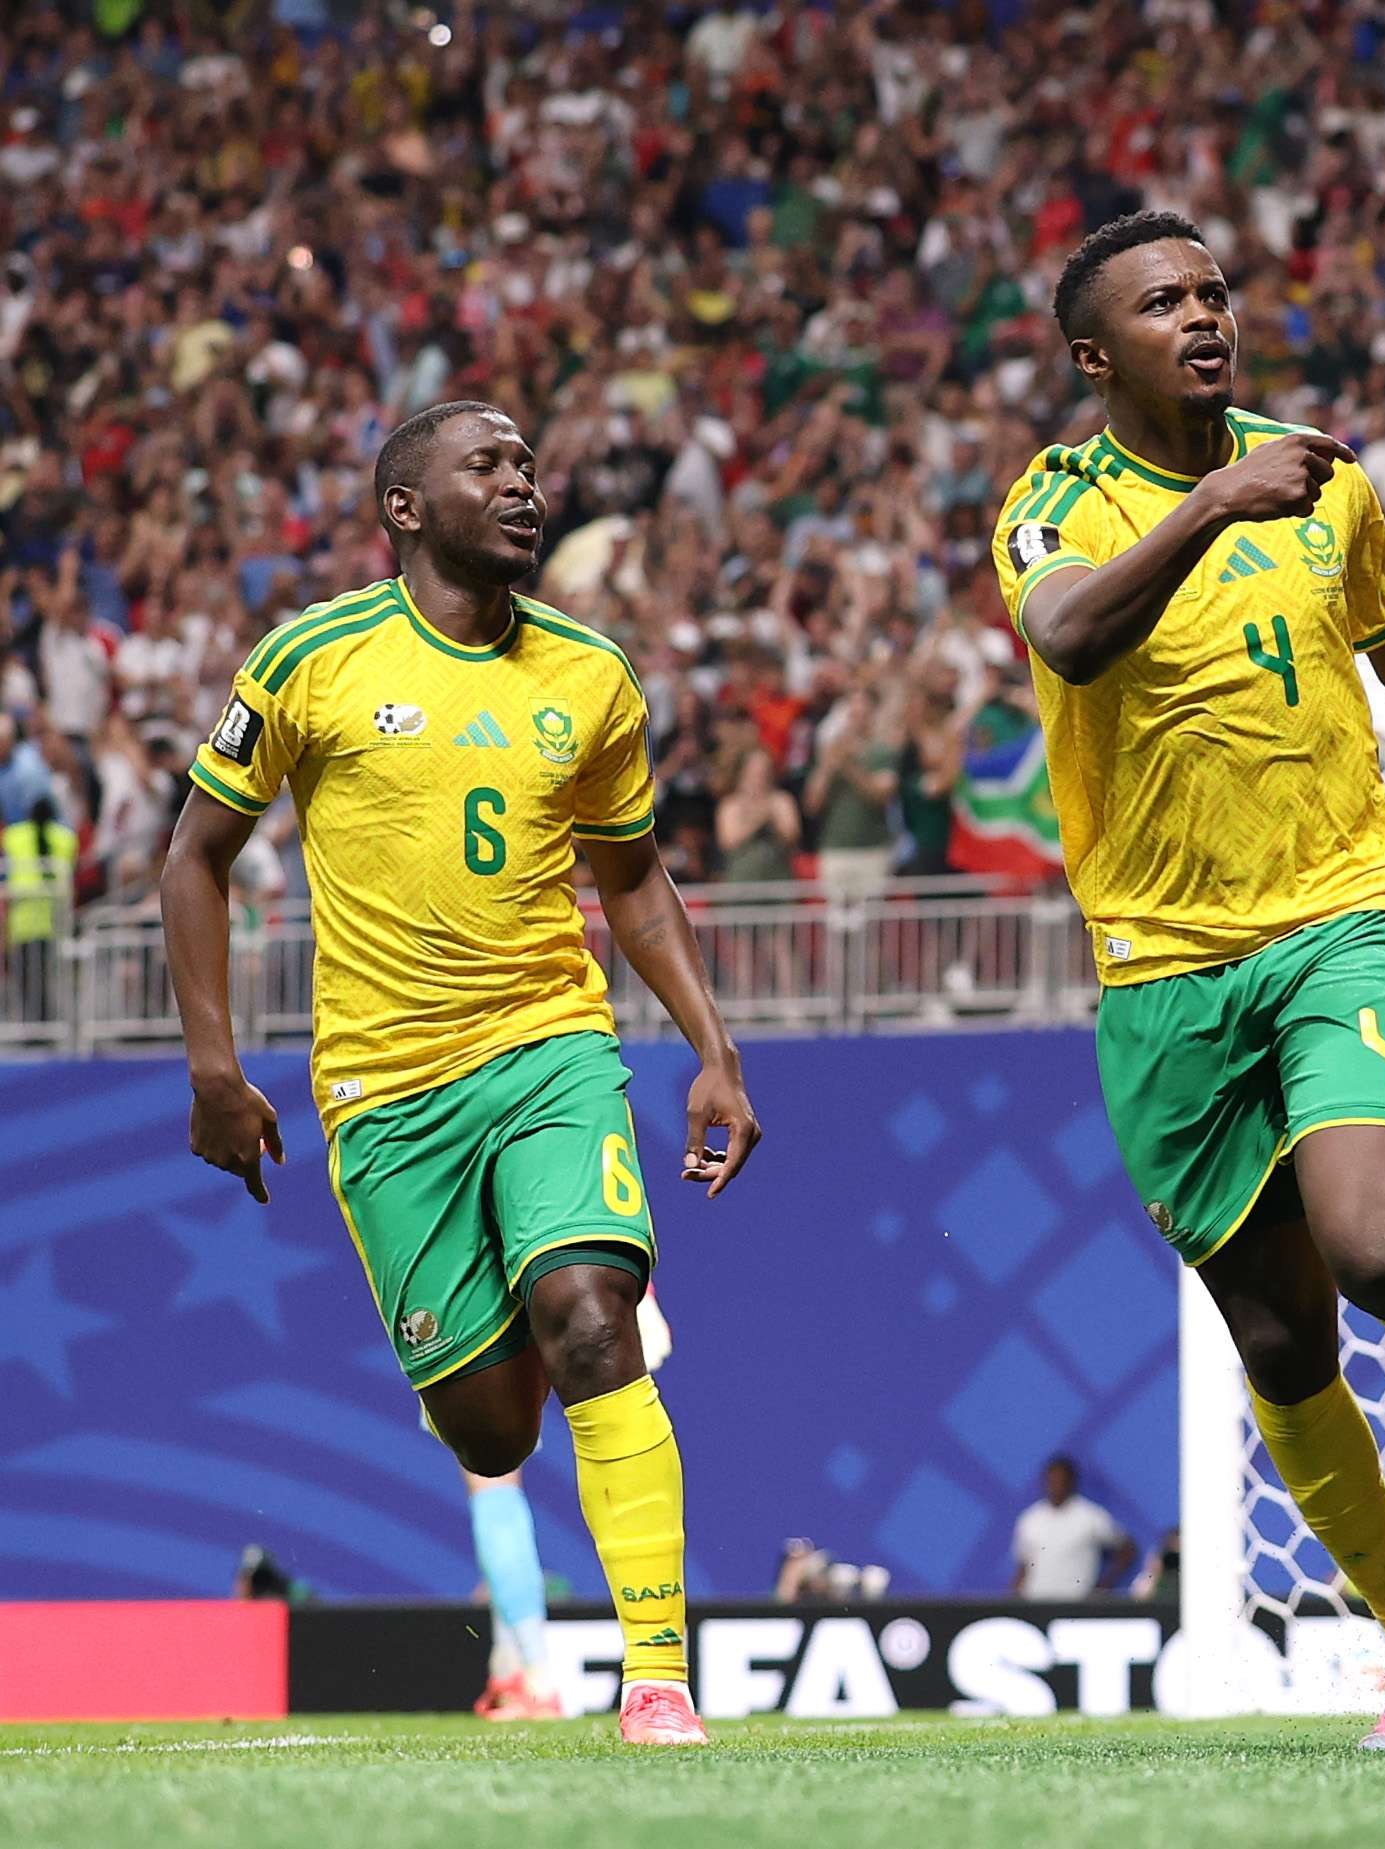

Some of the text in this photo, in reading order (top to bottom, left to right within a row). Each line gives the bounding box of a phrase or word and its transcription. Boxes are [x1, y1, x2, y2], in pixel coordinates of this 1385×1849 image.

[1242, 614, 1300, 708] 4
[464, 786, 507, 876] 6
[602, 1132, 643, 1217] 6
[622, 1581, 682, 1603] SAFA
[546, 1617, 900, 1718] FFA
